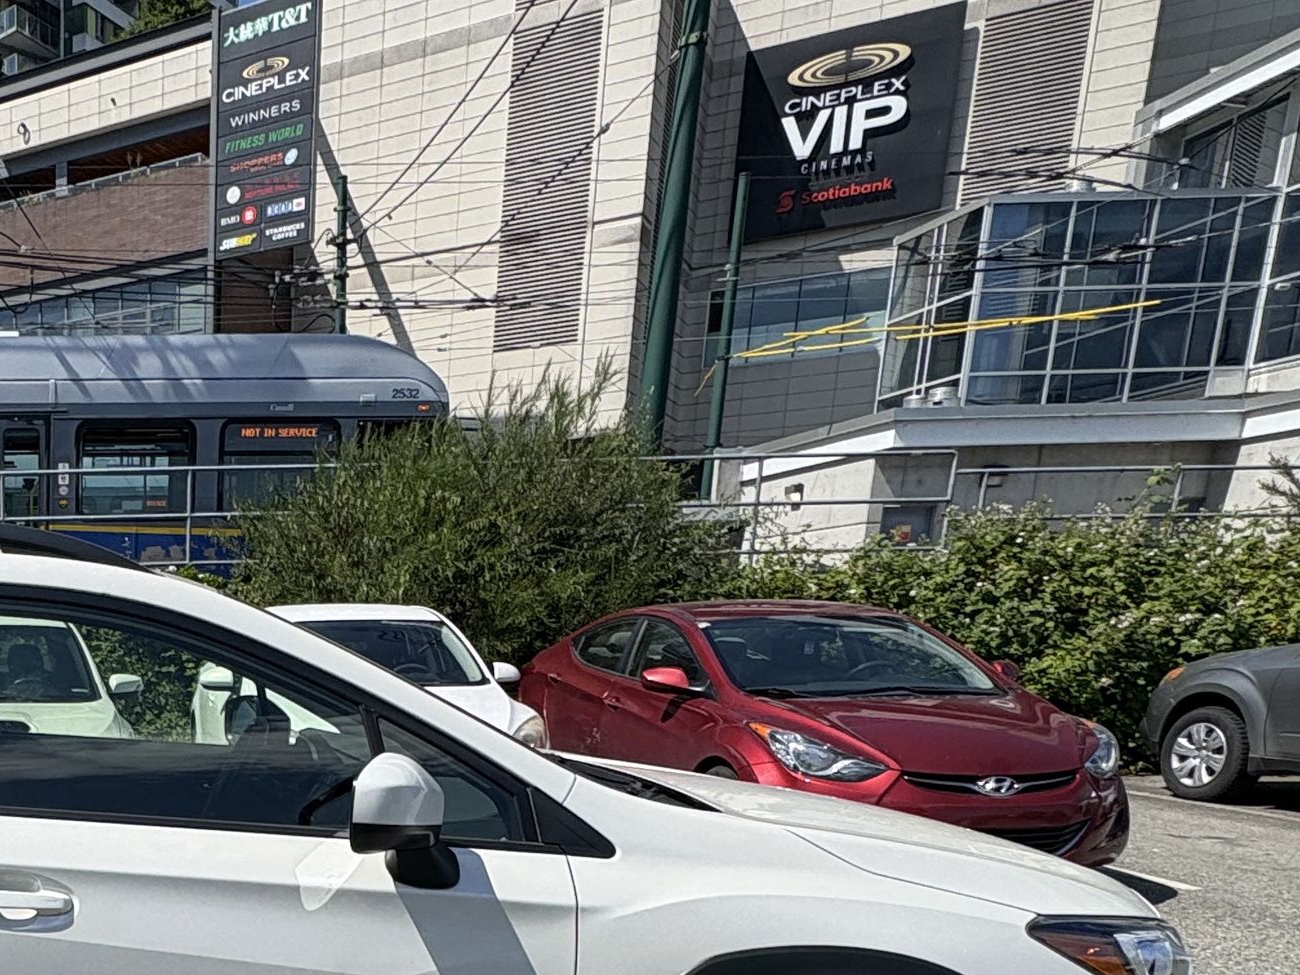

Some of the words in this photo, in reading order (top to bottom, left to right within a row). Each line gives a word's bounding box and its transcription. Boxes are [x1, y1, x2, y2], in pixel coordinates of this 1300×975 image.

[269, 2, 312, 33] T&T
[222, 66, 310, 103] CINEPLEX
[783, 75, 908, 114] CINEPLEX
[230, 99, 301, 128] WINNERS
[225, 133, 266, 154] FITNESS
[268, 123, 304, 143] WORLD
[781, 95, 908, 161] VIP
[229, 152, 284, 173] SHOPPERS
[801, 151, 874, 175] CINEMAS
[801, 176, 894, 204] Scotiabank
[220, 214, 240, 227] BMO
[264, 222, 305, 237] STARBUCKS
[392, 388, 420, 399] 2532
[241, 428, 260, 438] NOT
[263, 428, 276, 438] IN
[278, 427, 318, 438] SERVICE
